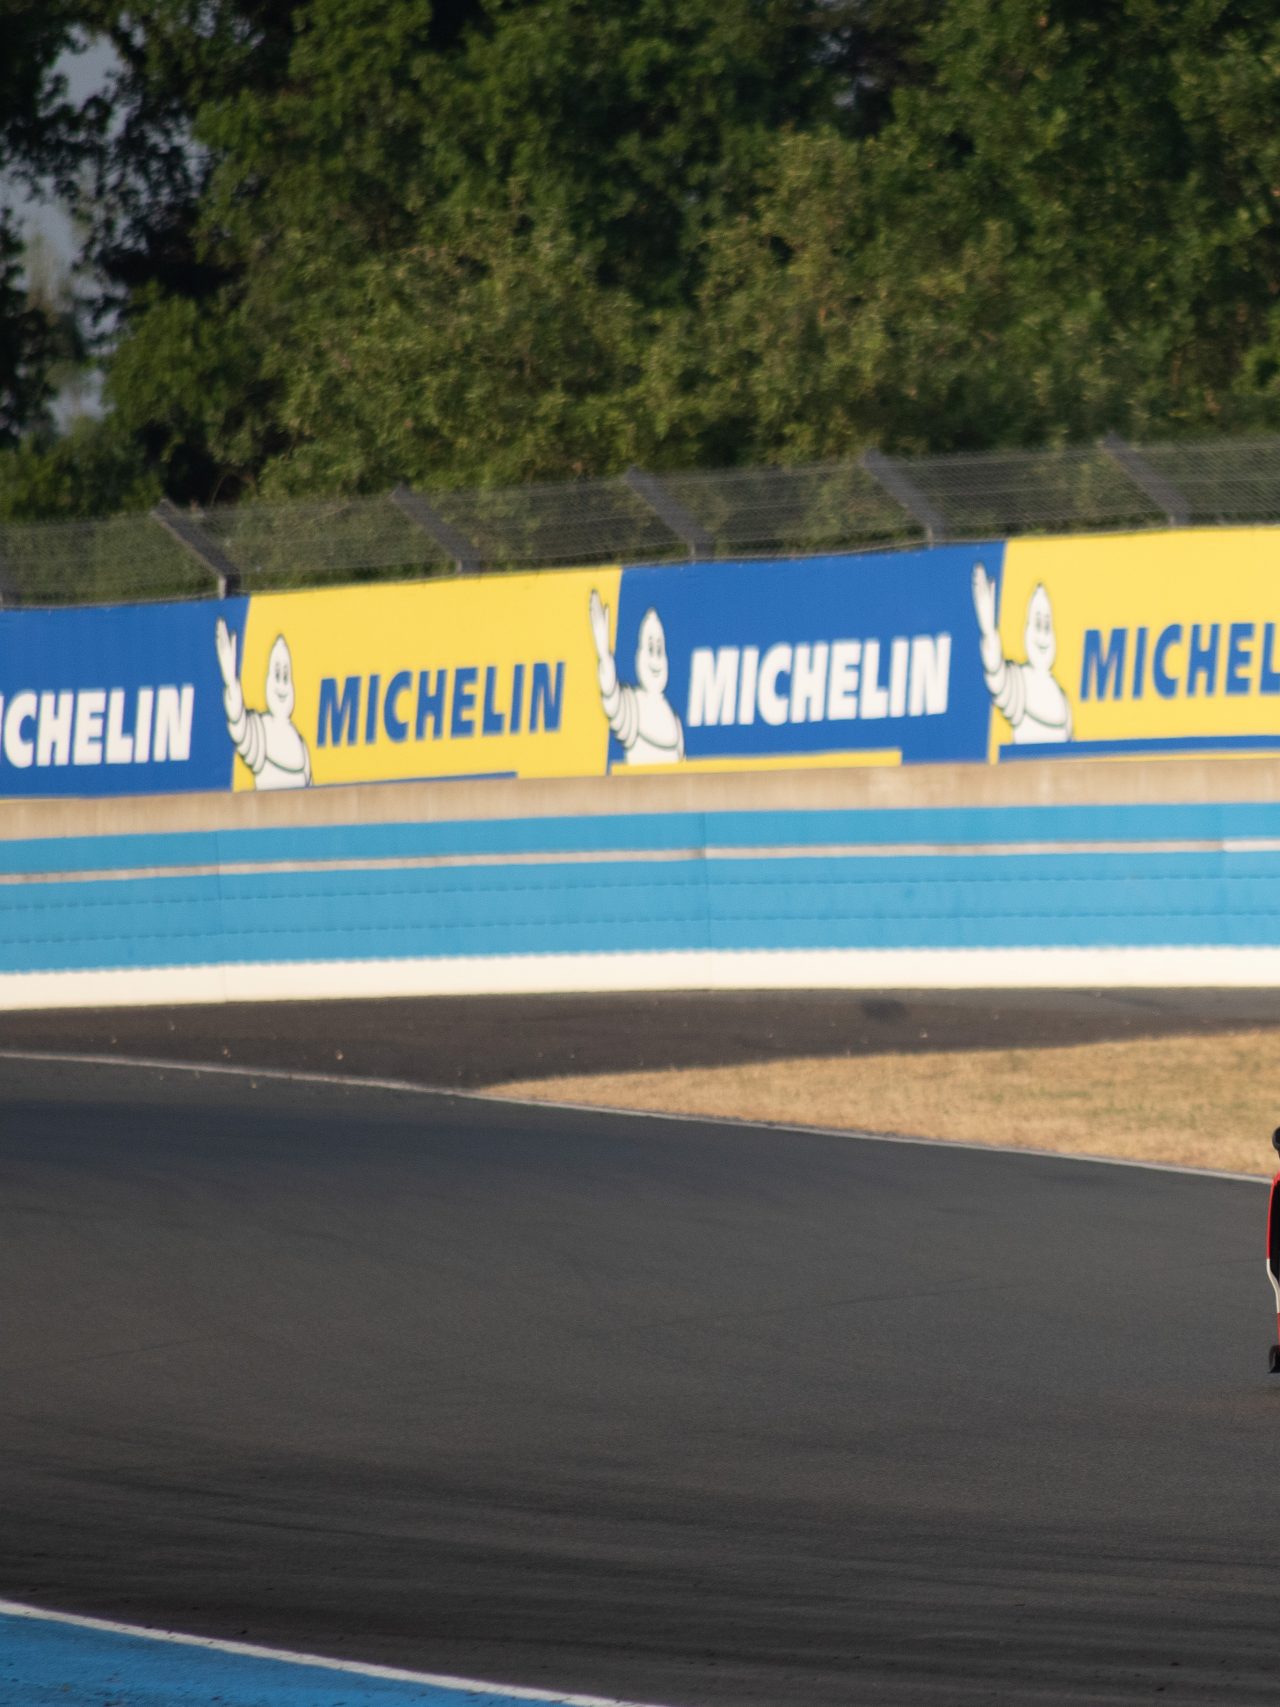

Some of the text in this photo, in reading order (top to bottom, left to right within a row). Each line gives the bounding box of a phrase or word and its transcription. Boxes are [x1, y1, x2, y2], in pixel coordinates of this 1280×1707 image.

[317, 662, 565, 746] MICHELIN
[687, 634, 951, 728] MICHELIN
[0, 684, 194, 768] CHELIN
